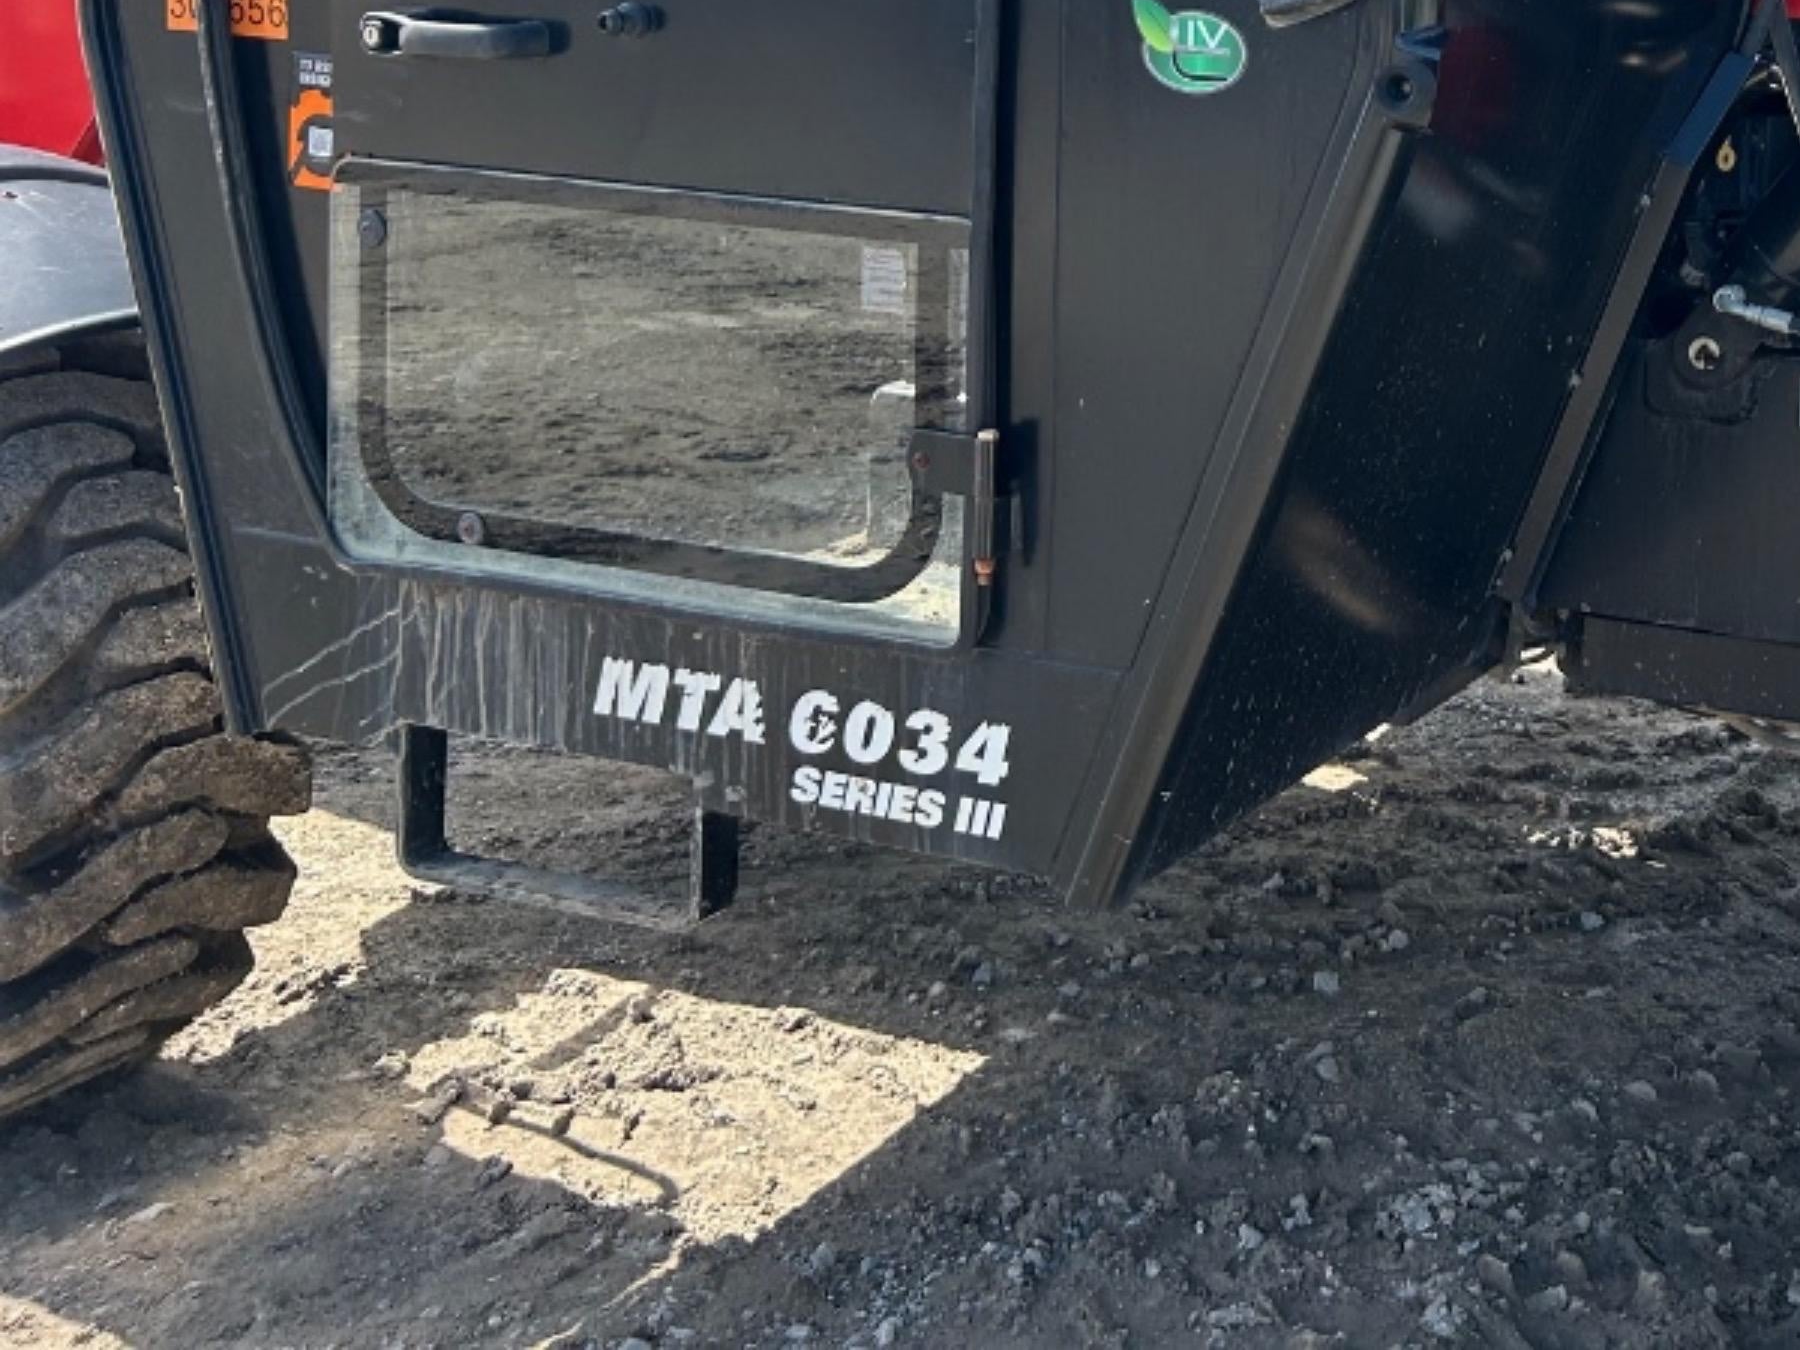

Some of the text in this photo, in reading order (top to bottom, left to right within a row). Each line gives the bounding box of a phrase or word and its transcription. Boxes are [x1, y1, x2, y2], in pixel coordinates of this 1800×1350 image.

[593, 655, 766, 745] MTA
[789, 767, 1008, 841] SERIES III
